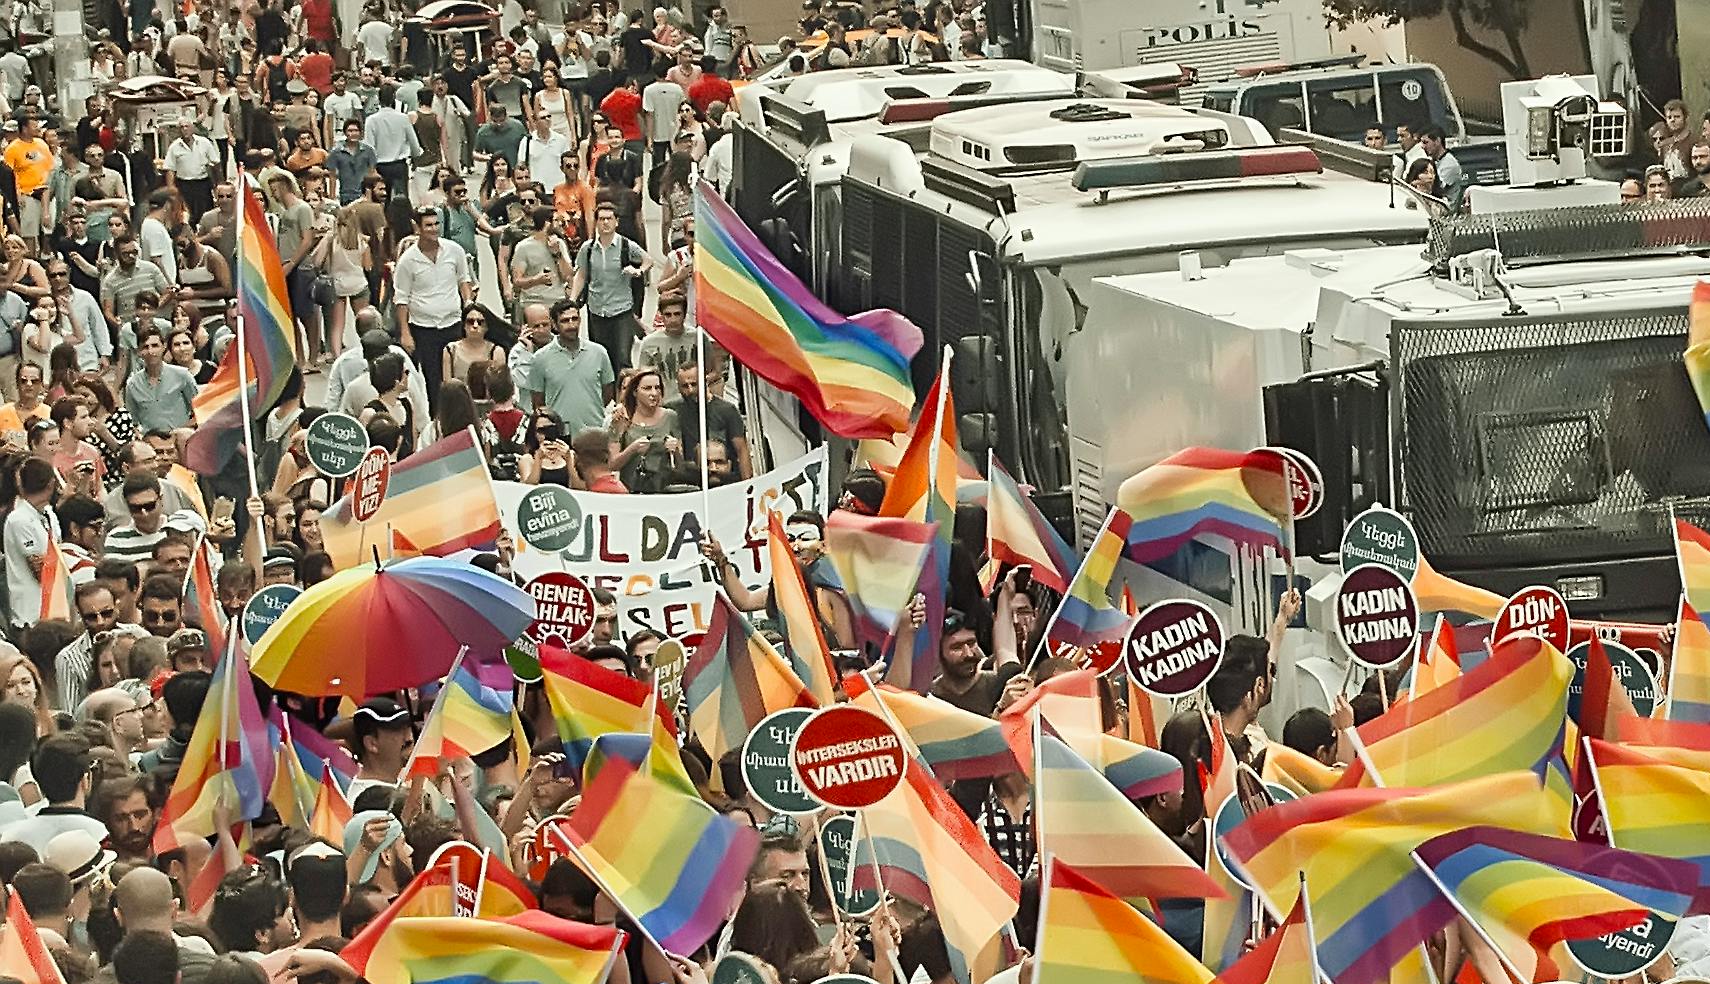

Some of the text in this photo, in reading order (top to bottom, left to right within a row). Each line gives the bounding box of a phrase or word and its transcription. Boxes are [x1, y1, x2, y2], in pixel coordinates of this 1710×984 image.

[1361, 521, 1405, 548] Կեցցե
[530, 581, 588, 607] GENEL
[1341, 586, 1407, 618] KADIN
[1343, 614, 1413, 646] KADINA
[1509, 596, 1561, 631] DÖN-
[1131, 611, 1209, 662] KADIN
[1138, 637, 1219, 687] KADINA
[808, 755, 898, 790] VARDIR
